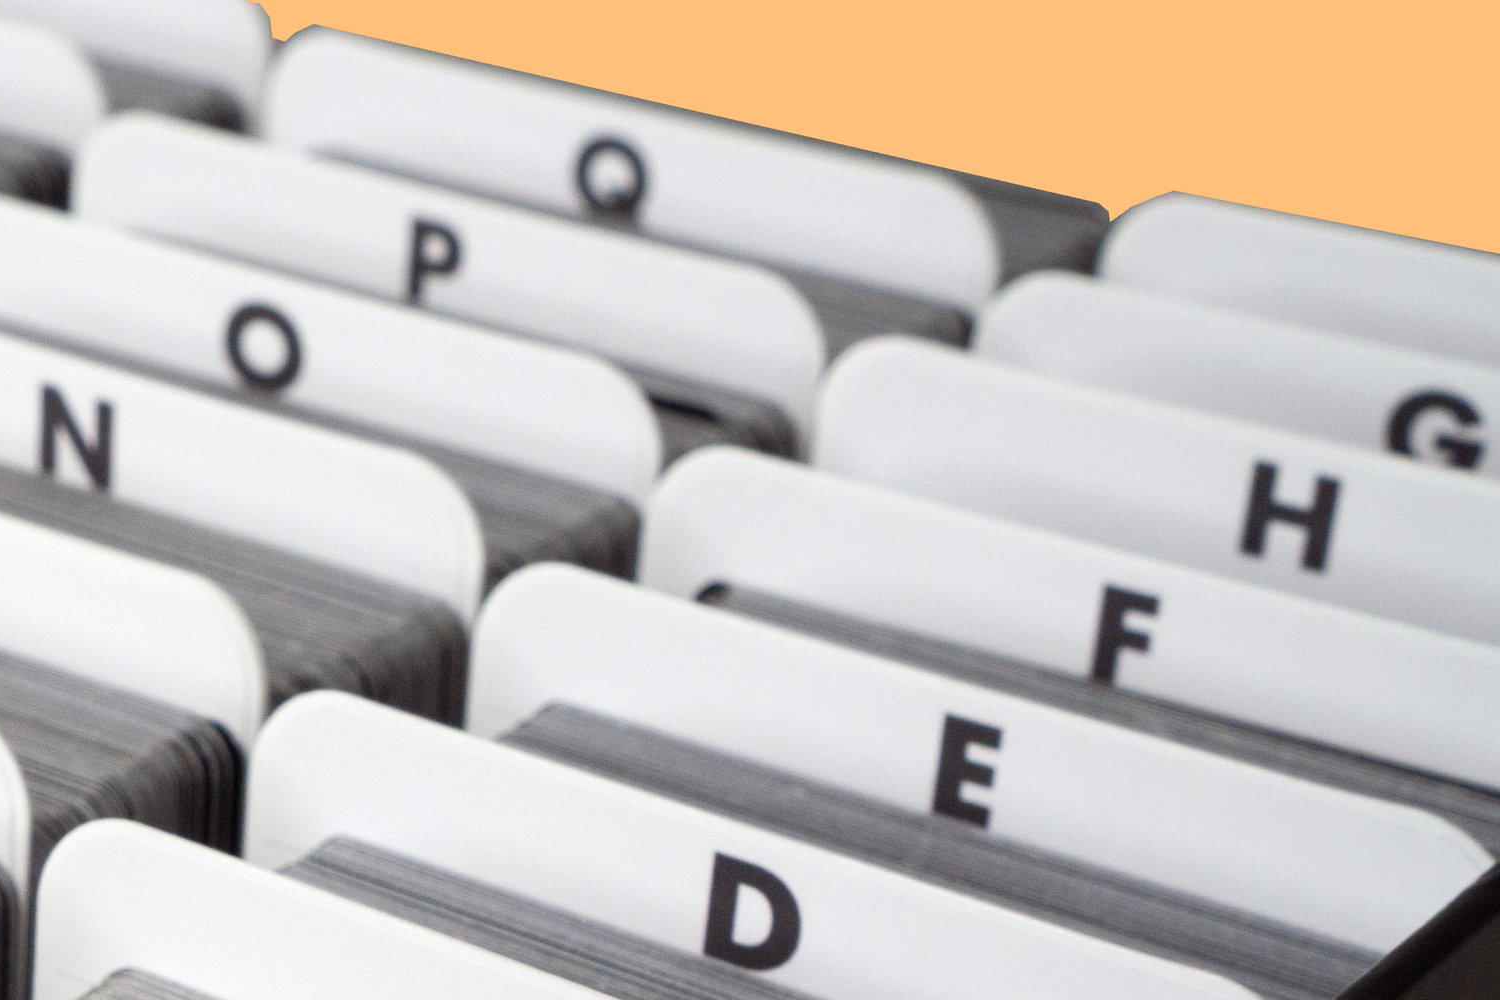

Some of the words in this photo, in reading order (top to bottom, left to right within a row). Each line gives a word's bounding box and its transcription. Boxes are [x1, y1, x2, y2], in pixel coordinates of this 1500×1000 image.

[573, 136, 648, 226] Q
[404, 219, 462, 304] P
[225, 303, 303, 390] O
[40, 387, 113, 489] N
[1383, 388, 1484, 472] G
[1239, 461, 1341, 573] H
[1090, 585, 1161, 688] F
[931, 714, 1004, 830] E
[703, 853, 801, 971] D
